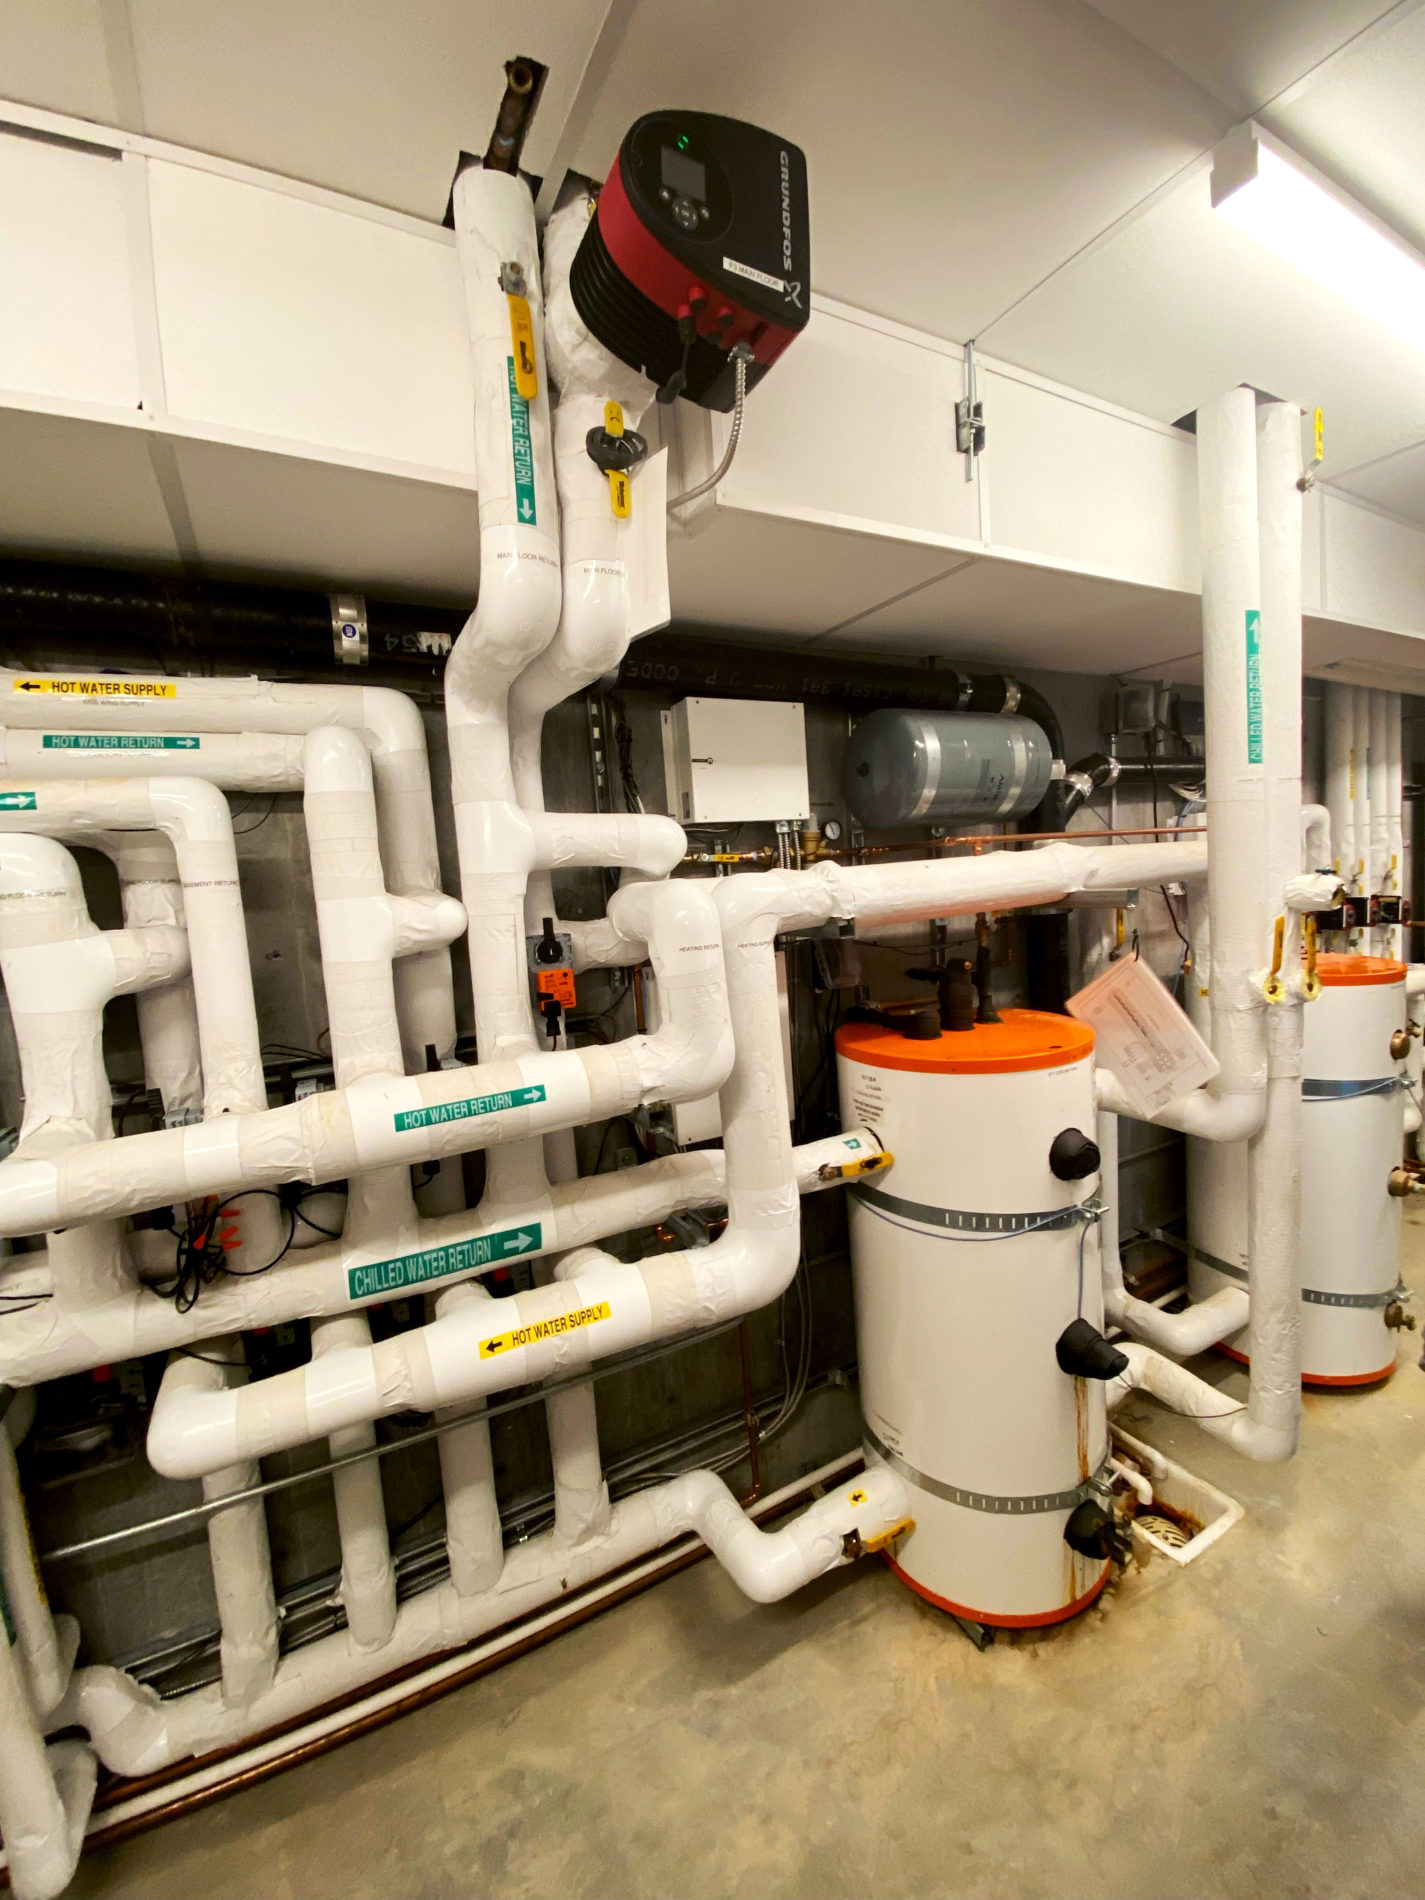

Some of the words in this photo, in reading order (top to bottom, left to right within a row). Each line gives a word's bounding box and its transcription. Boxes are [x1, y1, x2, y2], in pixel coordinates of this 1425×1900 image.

[780, 150, 792, 272] GRUNDFOS
[514, 440, 532, 485] RETURN
[52, 681, 76, 693] HOT
[80, 682, 121, 694] WATER
[123, 683, 167, 696] SUPPLY
[52, 736, 76, 747] HOT
[78, 736, 118, 748] WATER
[120, 737, 164, 748] RETURN
[404, 1110, 427, 1128] HOT
[429, 1102, 469, 1123] WATER
[470, 1093, 513, 1114] RETURN
[354, 1261, 404, 1295] CHILLED
[406, 1250, 446, 1282] WATER
[448, 1238, 492, 1269] RETURN
[511, 1327, 532, 1347] HOT
[533, 1317, 568, 1339] WATER
[568, 1305, 603, 1328] SUPPLY
